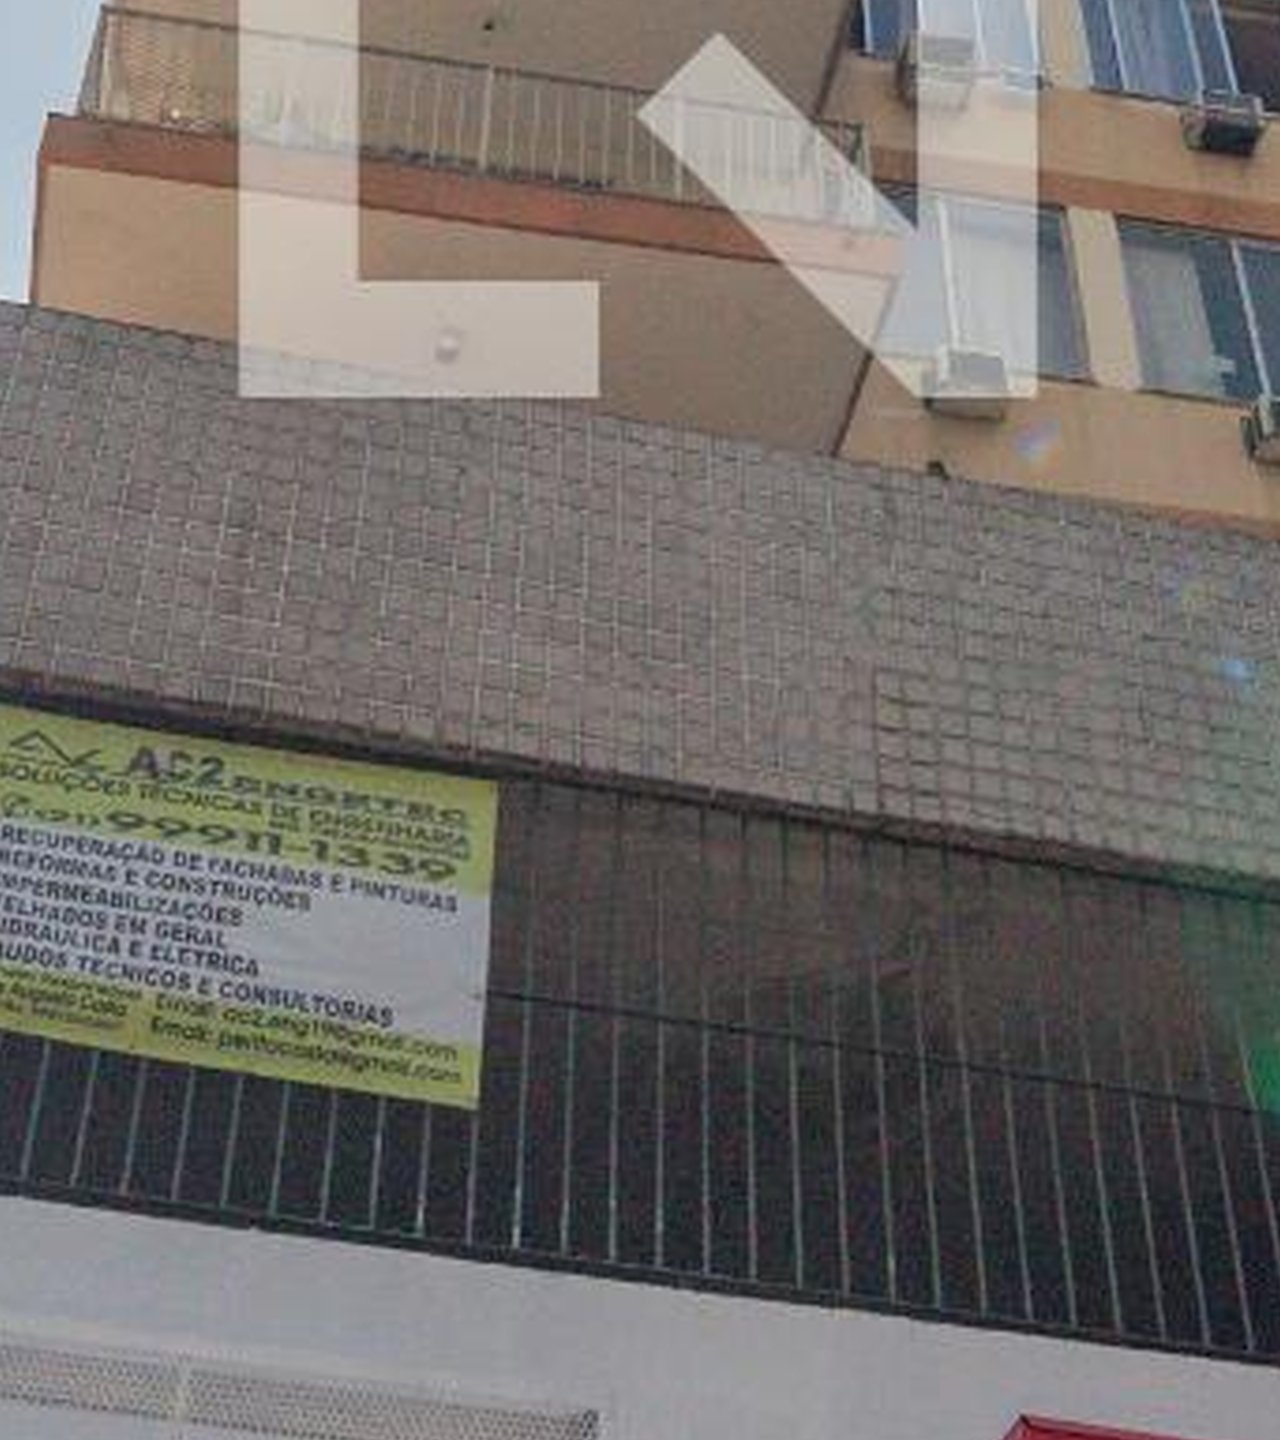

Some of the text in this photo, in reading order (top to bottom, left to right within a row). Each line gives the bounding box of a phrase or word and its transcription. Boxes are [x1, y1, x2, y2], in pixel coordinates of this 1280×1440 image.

[124, 867, 138, 885] E
[173, 851, 202, 870] DE
[206, 856, 321, 890] FACHADAS
[328, 875, 342, 893] E
[348, 879, 457, 913] PINTURAS
[114, 914, 148, 935] EM
[154, 920, 228, 949] GERAL
[128, 939, 142, 957] E
[197, 976, 211, 994] E
